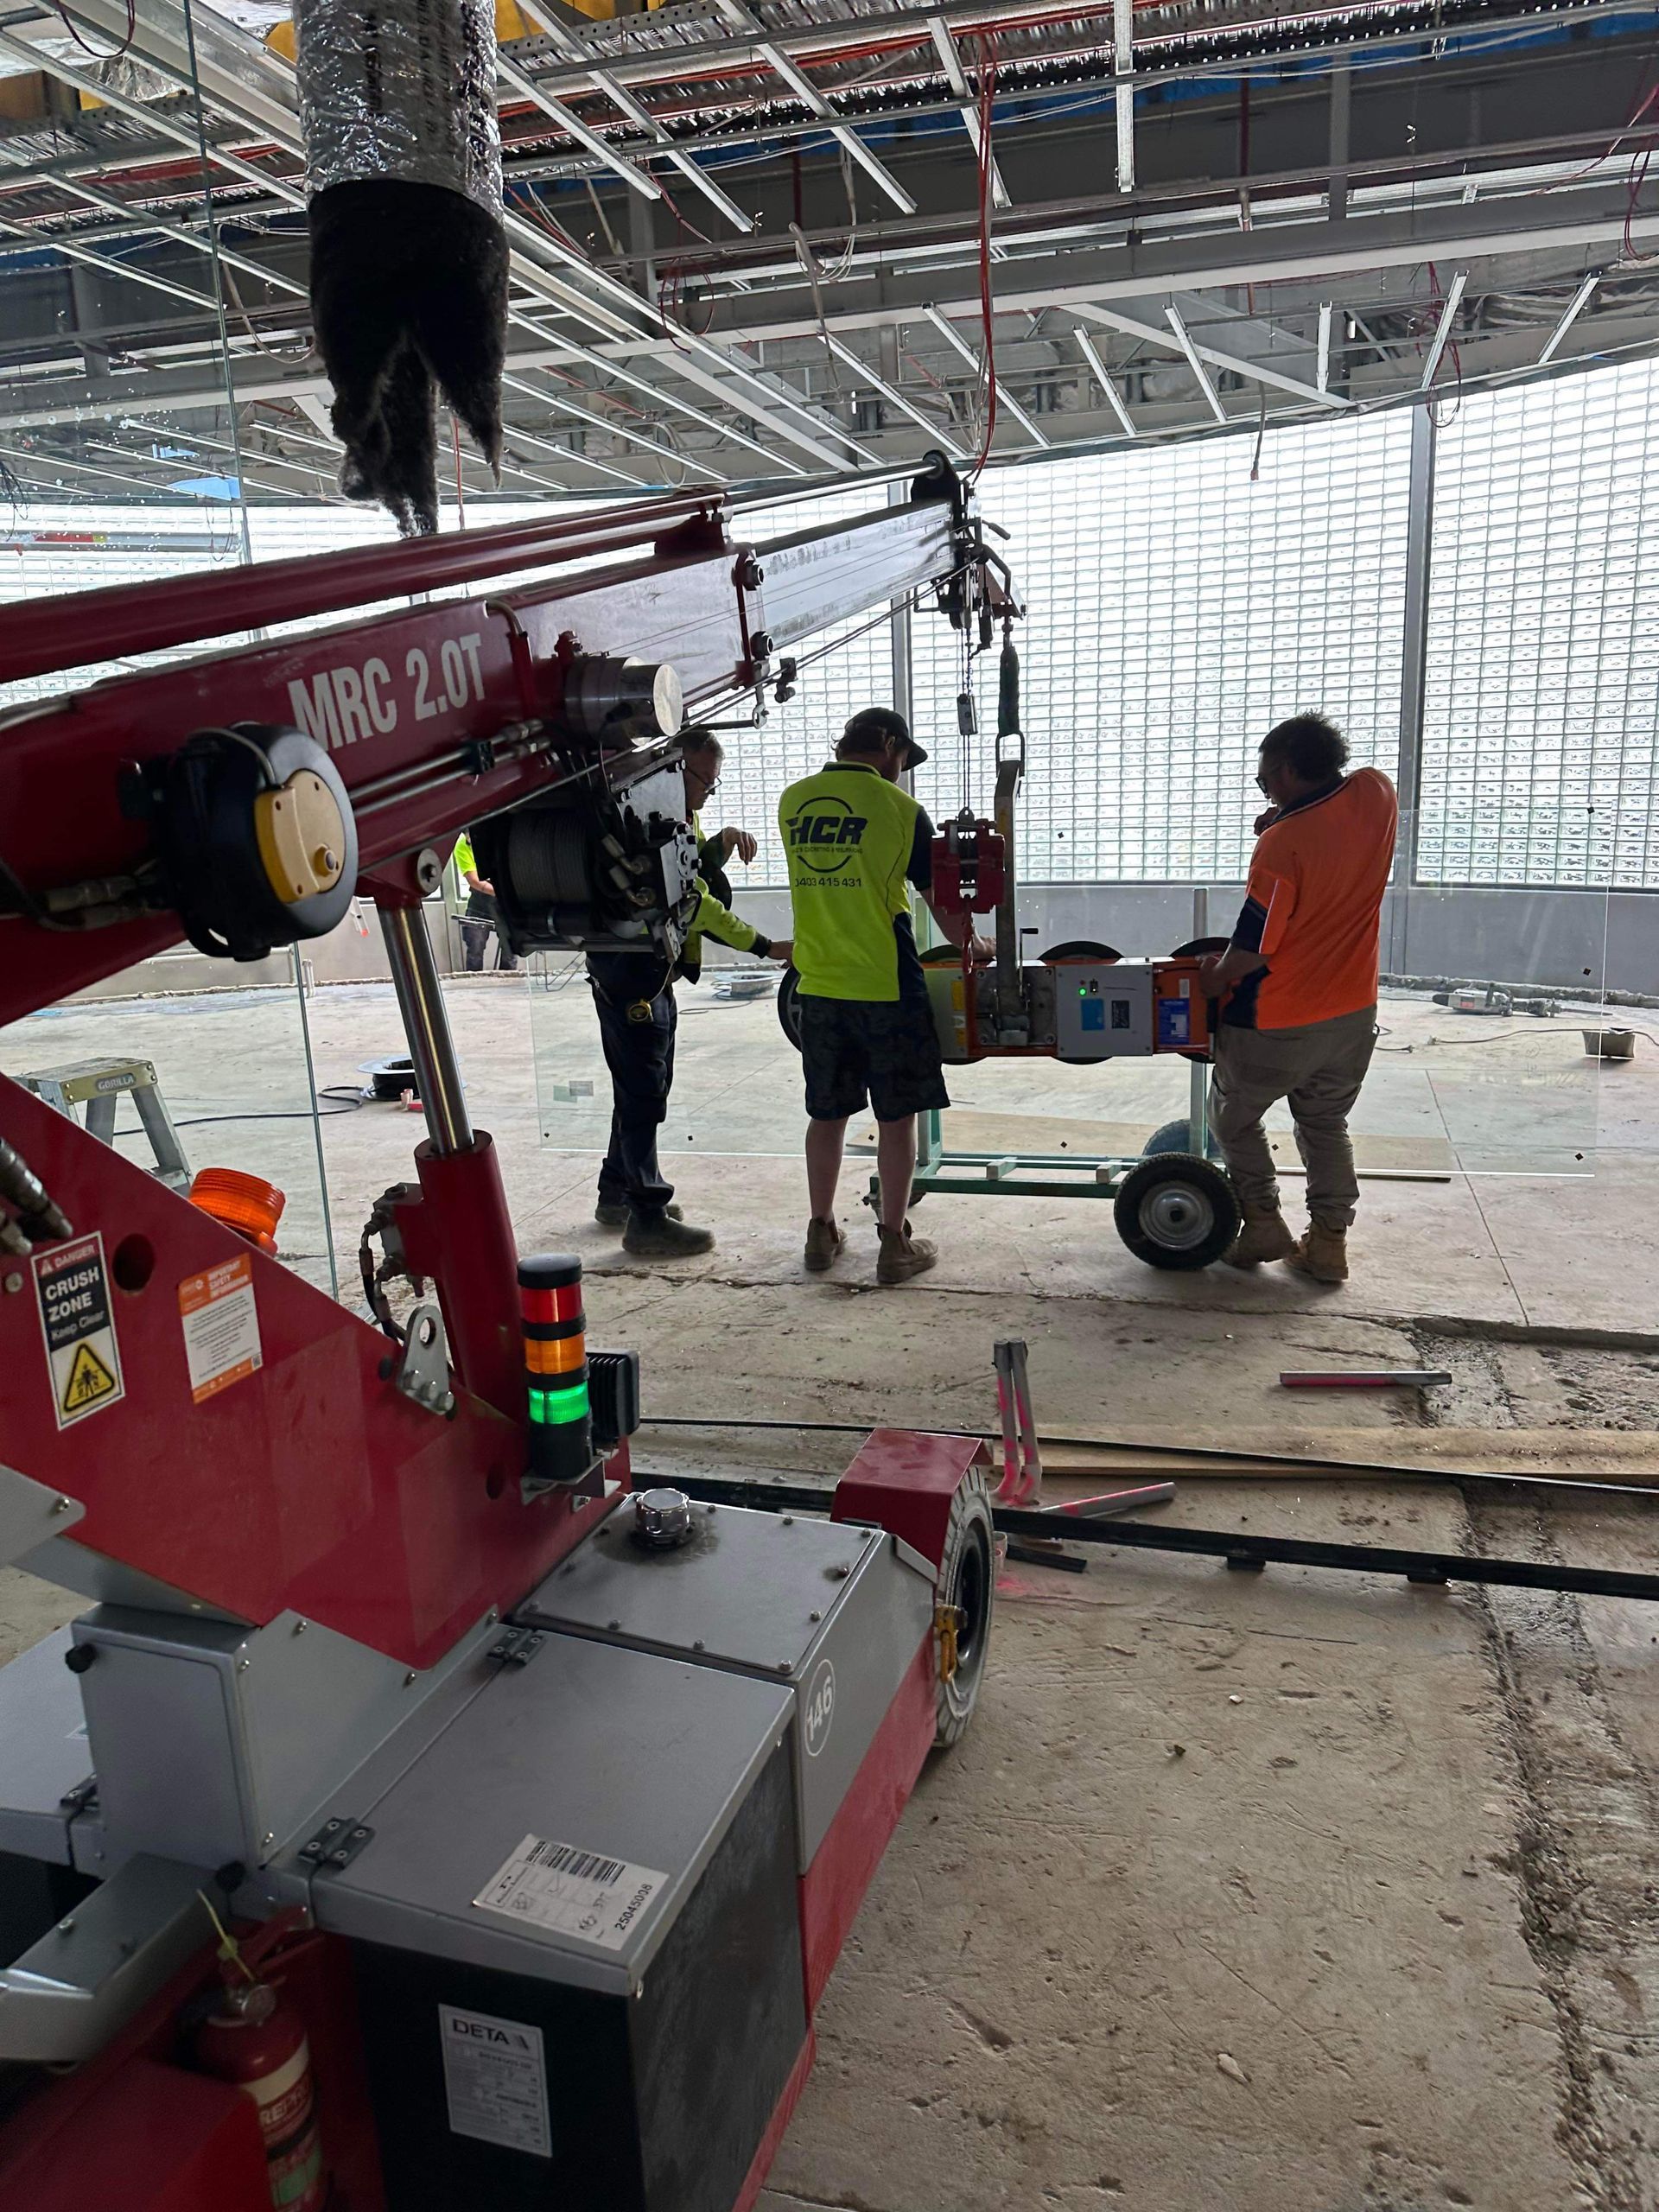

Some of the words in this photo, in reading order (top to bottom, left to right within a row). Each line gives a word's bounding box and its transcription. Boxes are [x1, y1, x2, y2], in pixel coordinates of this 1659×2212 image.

[287, 657, 397, 752] MRC
[405, 632, 485, 721] 2.0T
[785, 816, 868, 846] HCR
[818, 877, 840, 887] 415
[842, 878, 861, 887] 431
[98, 1075, 134, 1090] GORILLA
[54, 1244, 95, 1268] DANGER
[45, 1266, 99, 1300] CRUSH
[48, 1291, 92, 1323] ZONE
[51, 1323, 78, 1340] Keep
[79, 1310, 105, 1328] Clear
[806, 1675, 832, 1741] 146
[614, 1883, 653, 1931] 25045008
[452, 2018, 511, 2045] DETA
